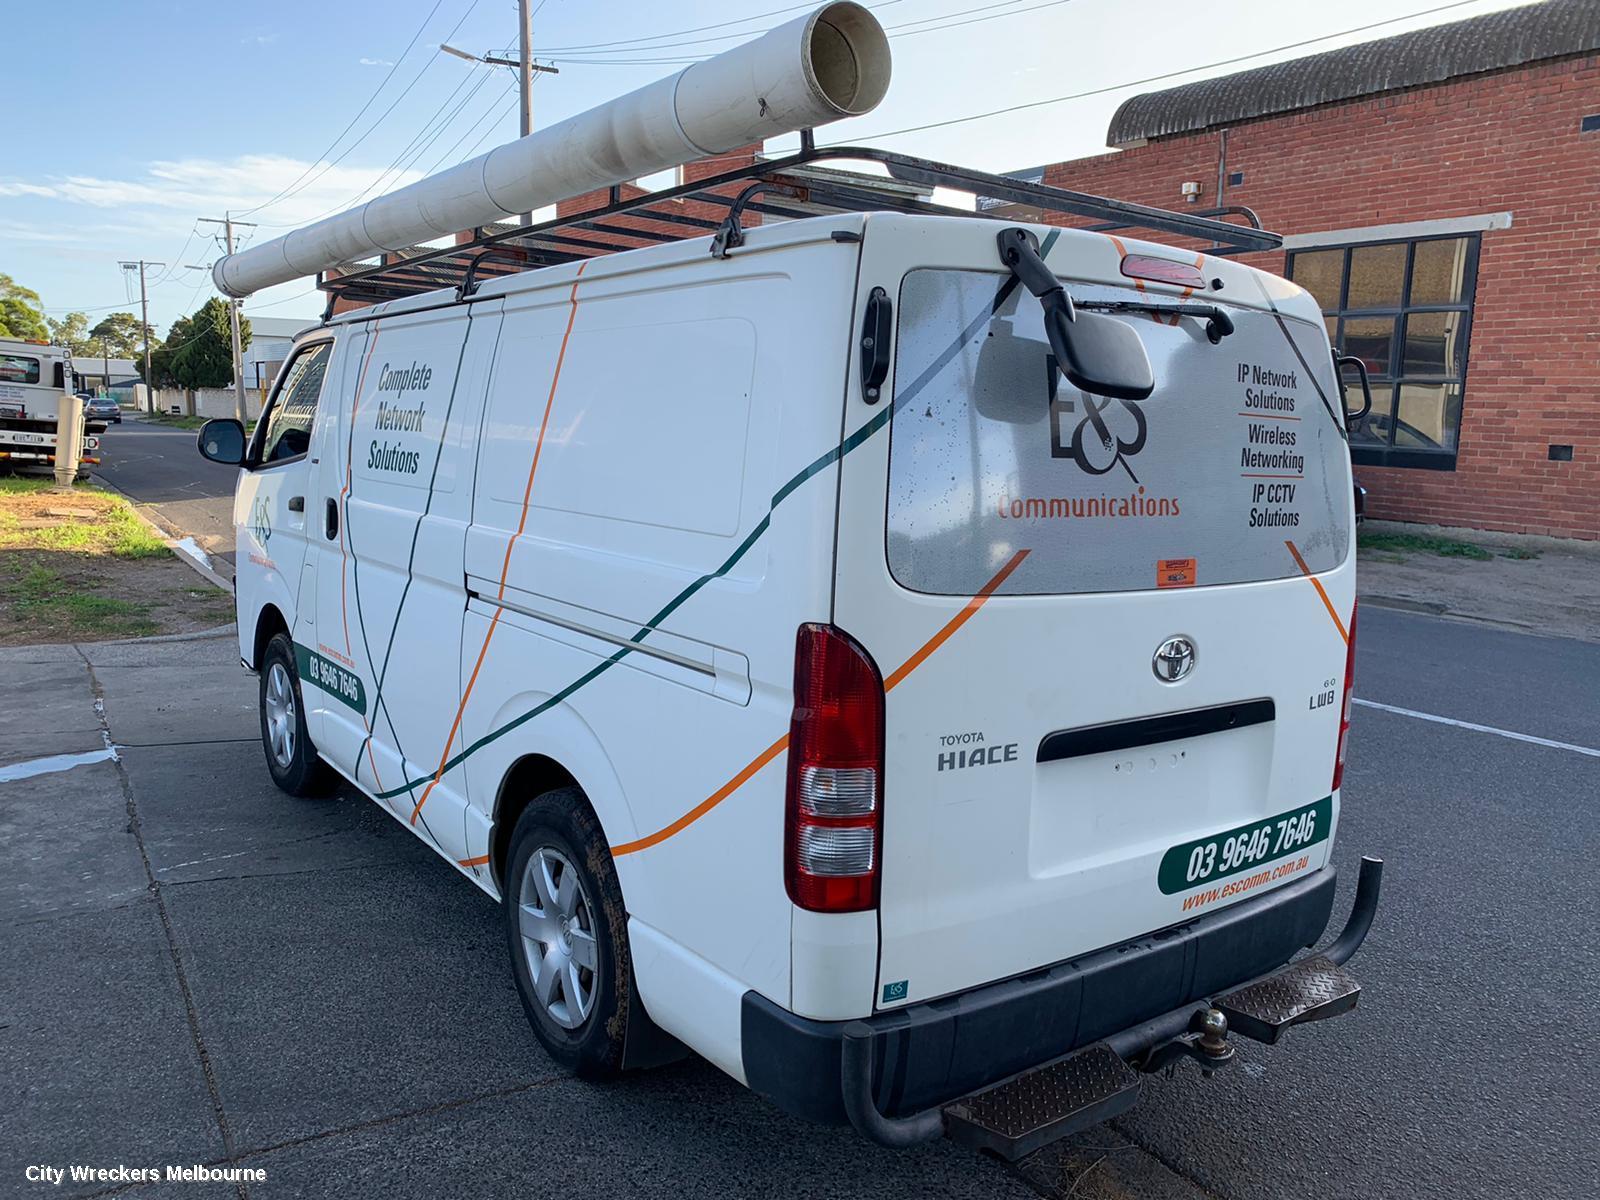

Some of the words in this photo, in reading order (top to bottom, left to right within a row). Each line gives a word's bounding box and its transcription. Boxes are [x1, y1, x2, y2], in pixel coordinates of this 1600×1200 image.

[378, 360, 432, 399] Complete
[1238, 363, 1249, 383] IP
[1252, 365, 1298, 389] Network
[1245, 388, 1295, 412] Solutions
[375, 401, 426, 433] Network
[1249, 423, 1296, 446] Wireless
[368, 439, 420, 475] Solutions
[1241, 447, 1304, 474] Networking
[998, 485, 1180, 519] Communications
[1252, 483, 1265, 503] IP
[1267, 484, 1296, 503] CCTV
[1249, 507, 1300, 528] Solutions
[309, 656, 319, 680] 03
[320, 661, 337, 690] 9646
[339, 671, 358, 702] 7646
[1309, 689, 1335, 710] LWB
[939, 731, 985, 747] TOYOTA
[937, 743, 1019, 772] HIACE
[1186, 842, 1218, 882] 03
[1218, 825, 1272, 872] 9646
[1273, 809, 1316, 854] 7646
[1182, 855, 1309, 912] www.escomm.com.au
